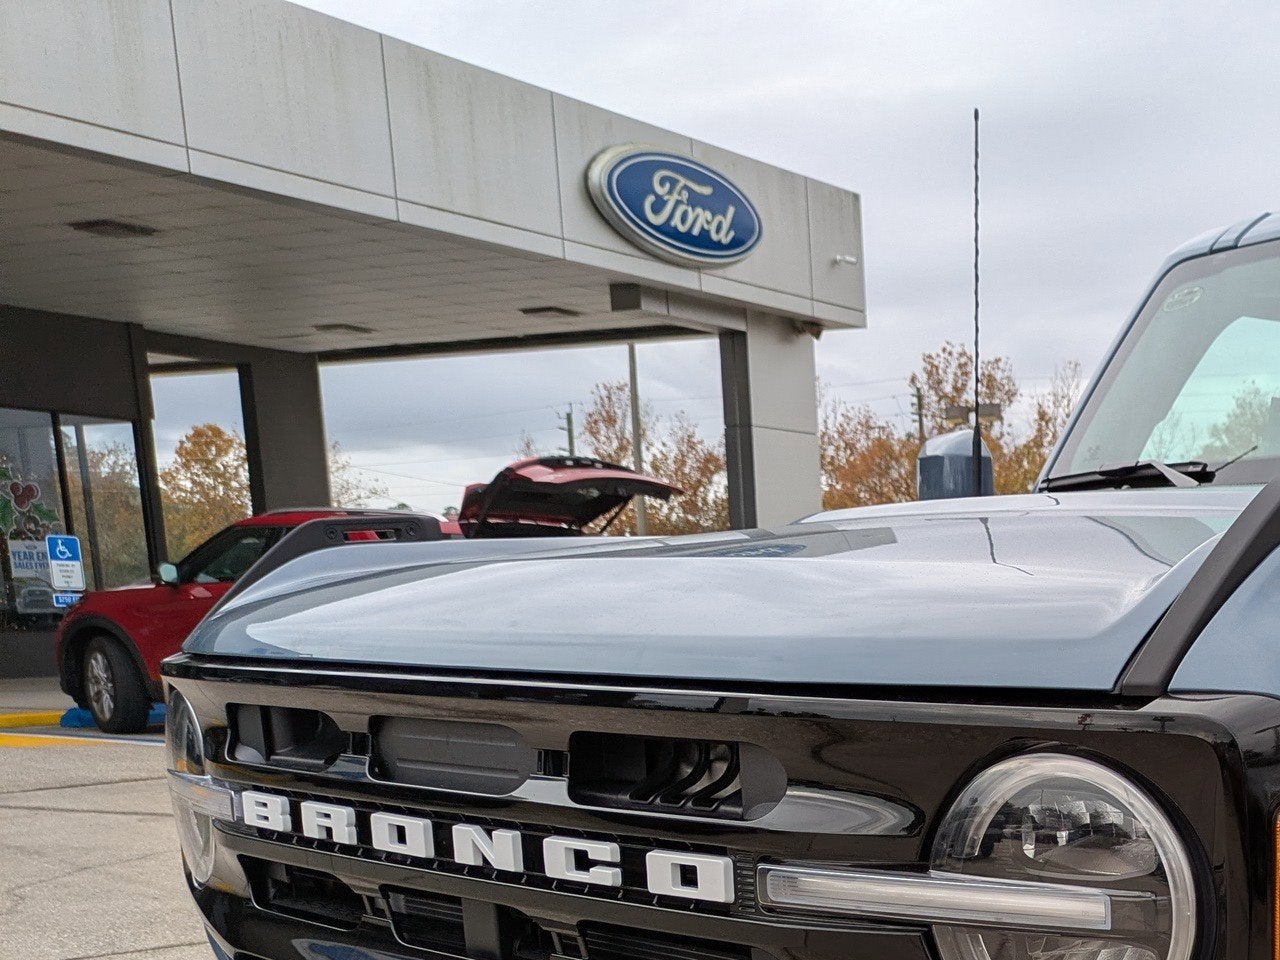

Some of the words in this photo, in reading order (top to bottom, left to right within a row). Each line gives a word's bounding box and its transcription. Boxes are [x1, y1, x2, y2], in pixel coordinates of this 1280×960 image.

[644, 168, 736, 245] Ford
[11, 551, 35, 561] YEAR
[242, 790, 735, 903] BRONCO
